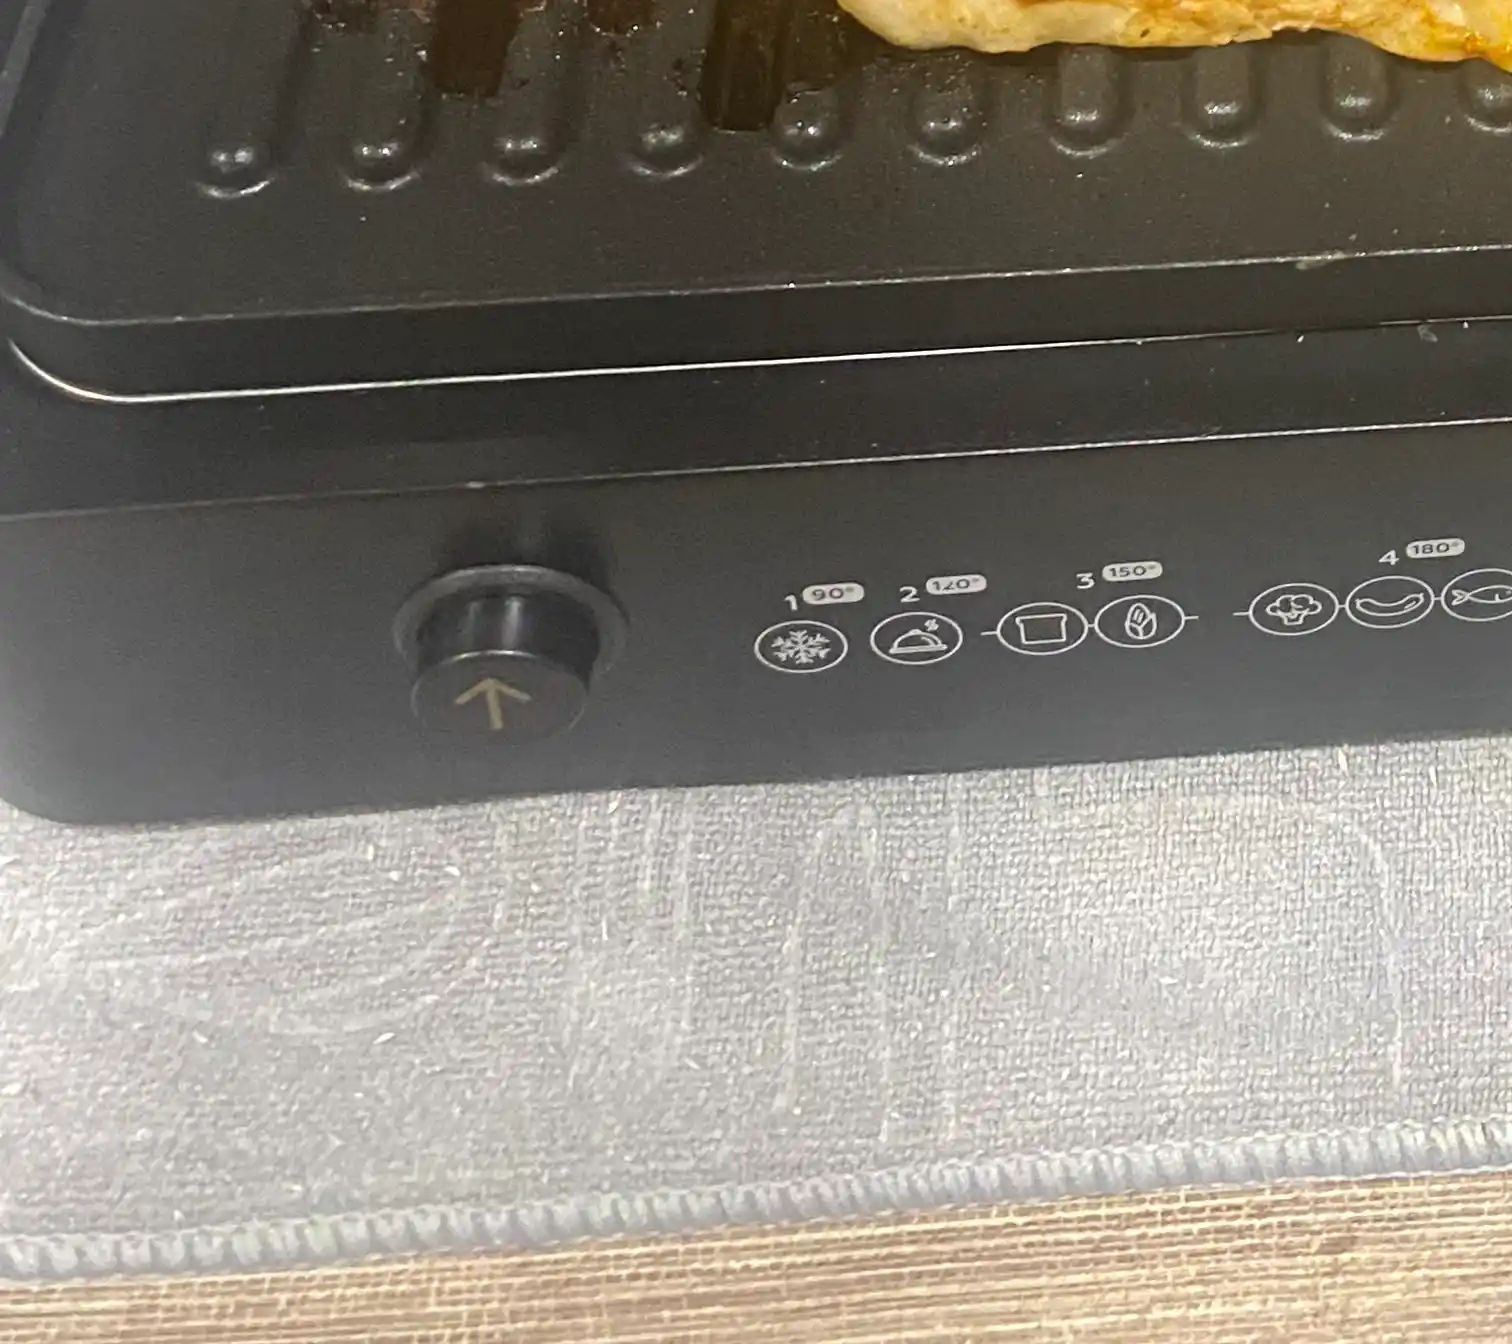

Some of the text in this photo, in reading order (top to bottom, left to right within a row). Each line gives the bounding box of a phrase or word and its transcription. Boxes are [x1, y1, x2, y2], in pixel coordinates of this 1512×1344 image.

[1378, 549, 1400, 566] 4
[1076, 572, 1096, 590] 3
[784, 594, 798, 611] 1
[900, 586, 921, 603] 2
